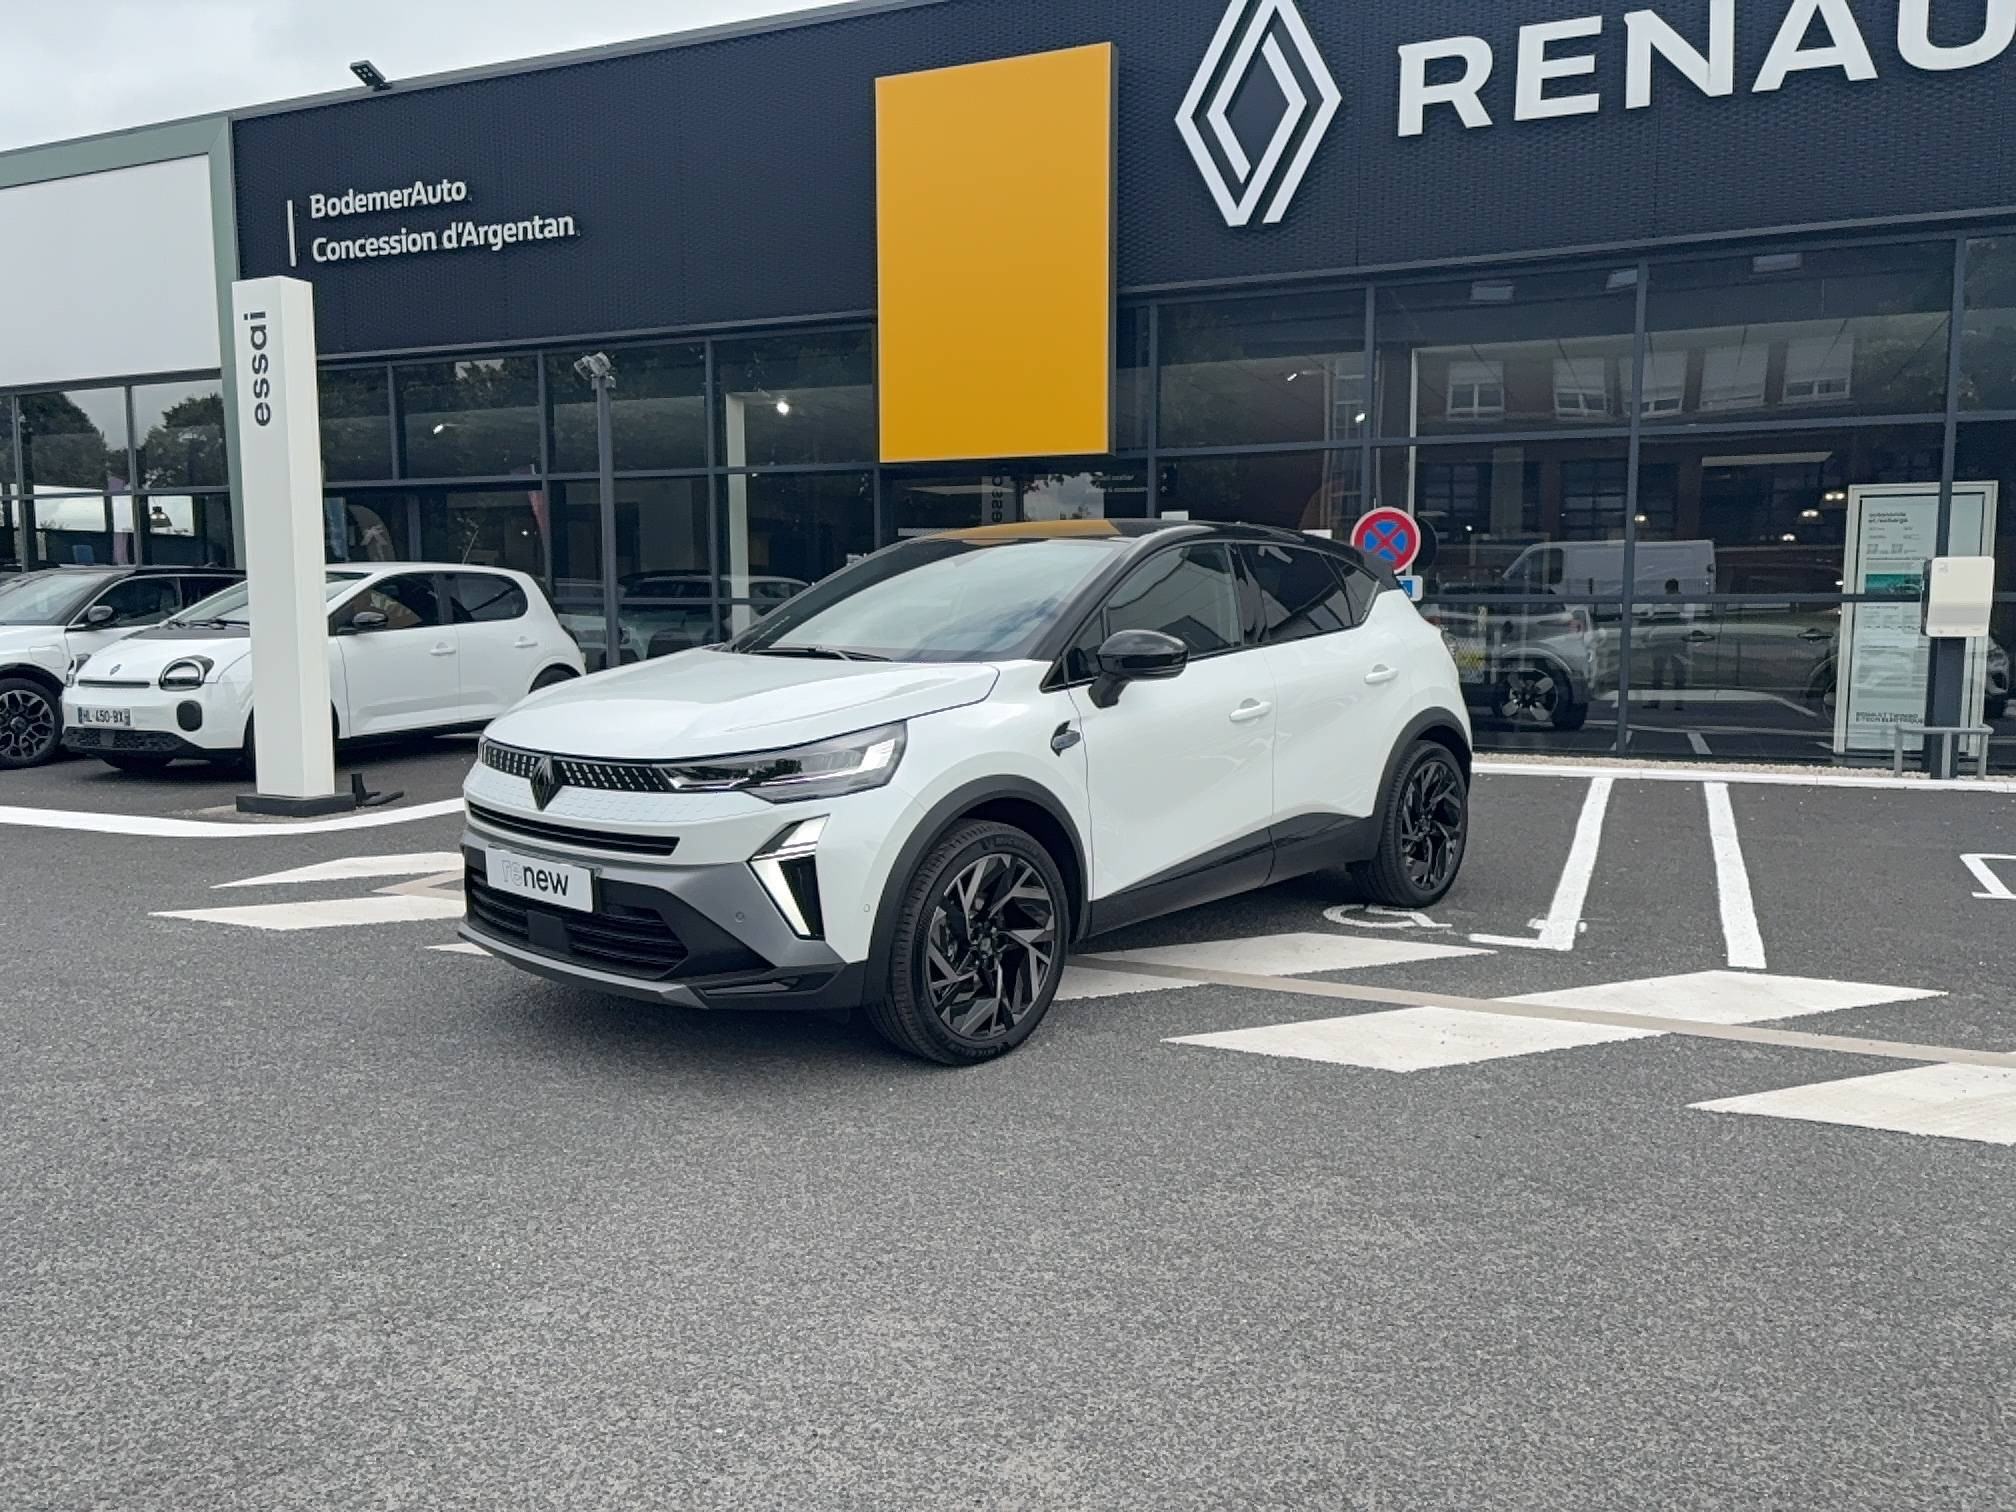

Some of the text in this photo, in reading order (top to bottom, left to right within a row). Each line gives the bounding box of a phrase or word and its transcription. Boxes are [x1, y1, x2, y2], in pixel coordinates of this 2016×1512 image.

[310, 178, 467, 219] BodemerAuto
[312, 215, 575, 263] Concession d'Argentan
[244, 311, 271, 427] essai
[501, 860, 569, 897] renew
